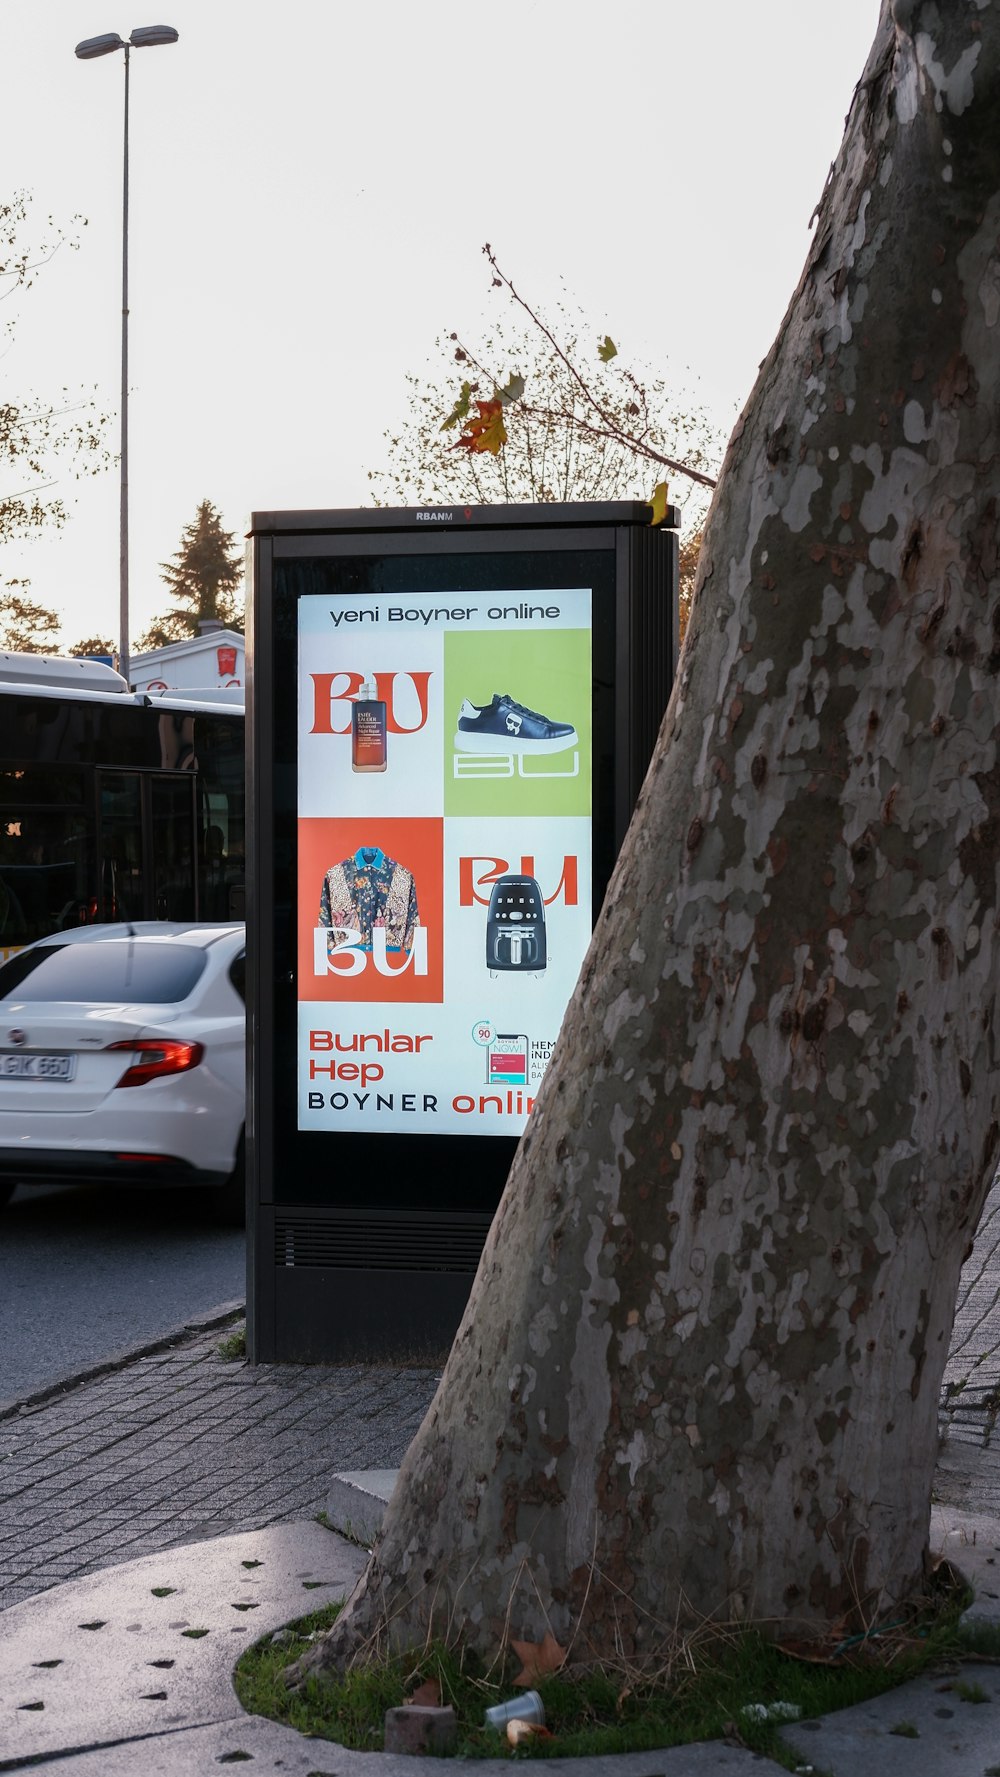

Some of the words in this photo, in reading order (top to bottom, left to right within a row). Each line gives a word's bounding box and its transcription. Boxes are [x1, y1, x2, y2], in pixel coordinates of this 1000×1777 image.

[416, 512, 453, 521] RBANM
[330, 605, 379, 627] yeni
[387, 607, 478, 626] Boyner
[487, 603, 560, 619] online
[308, 671, 434, 735] BU
[453, 751, 579, 779] BU
[459, 855, 578, 907] BU
[313, 926, 428, 977] BU
[309, 1028, 433, 1053] Bunlar
[478, 1029, 490, 1039] 90
[493, 1044, 522, 1054] NOW!
[309, 1059, 384, 1088] Hep
[308, 1092, 438, 1113] BOYNER
